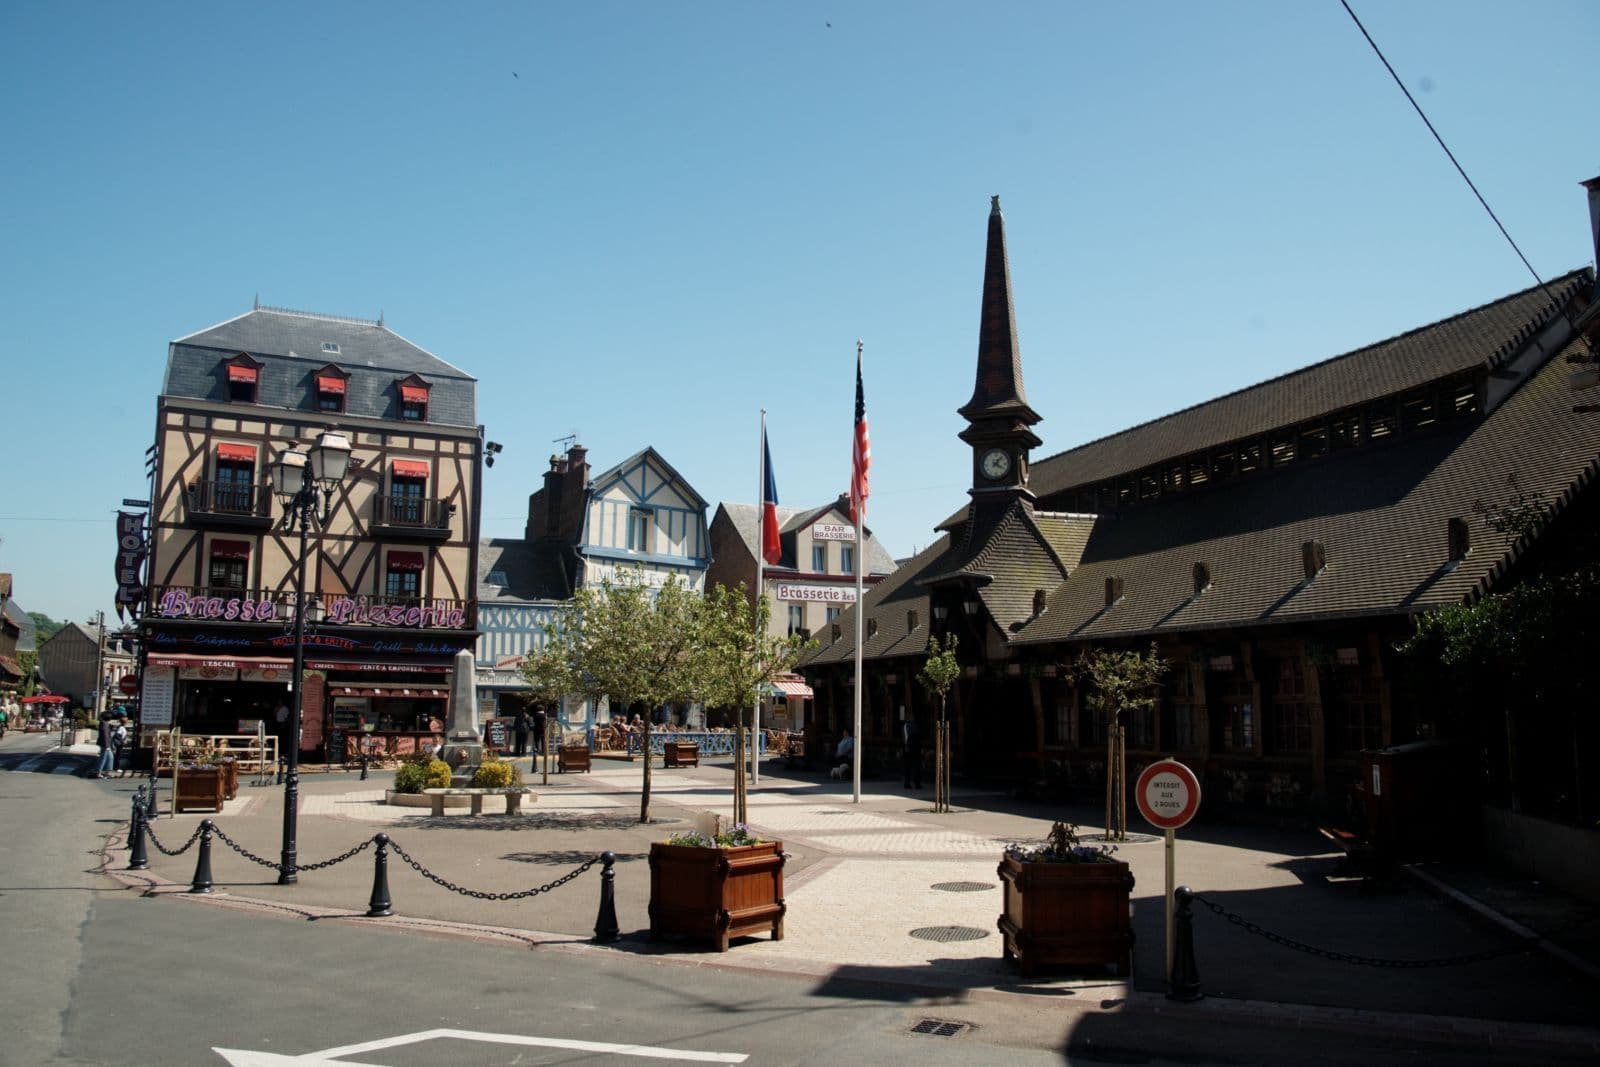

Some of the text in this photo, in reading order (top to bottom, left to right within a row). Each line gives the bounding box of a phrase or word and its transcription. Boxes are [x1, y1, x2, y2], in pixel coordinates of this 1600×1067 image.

[121, 518, 142, 602] HOTEL
[780, 585, 854, 601] Brasserie des
[329, 595, 465, 628] Pizzeria
